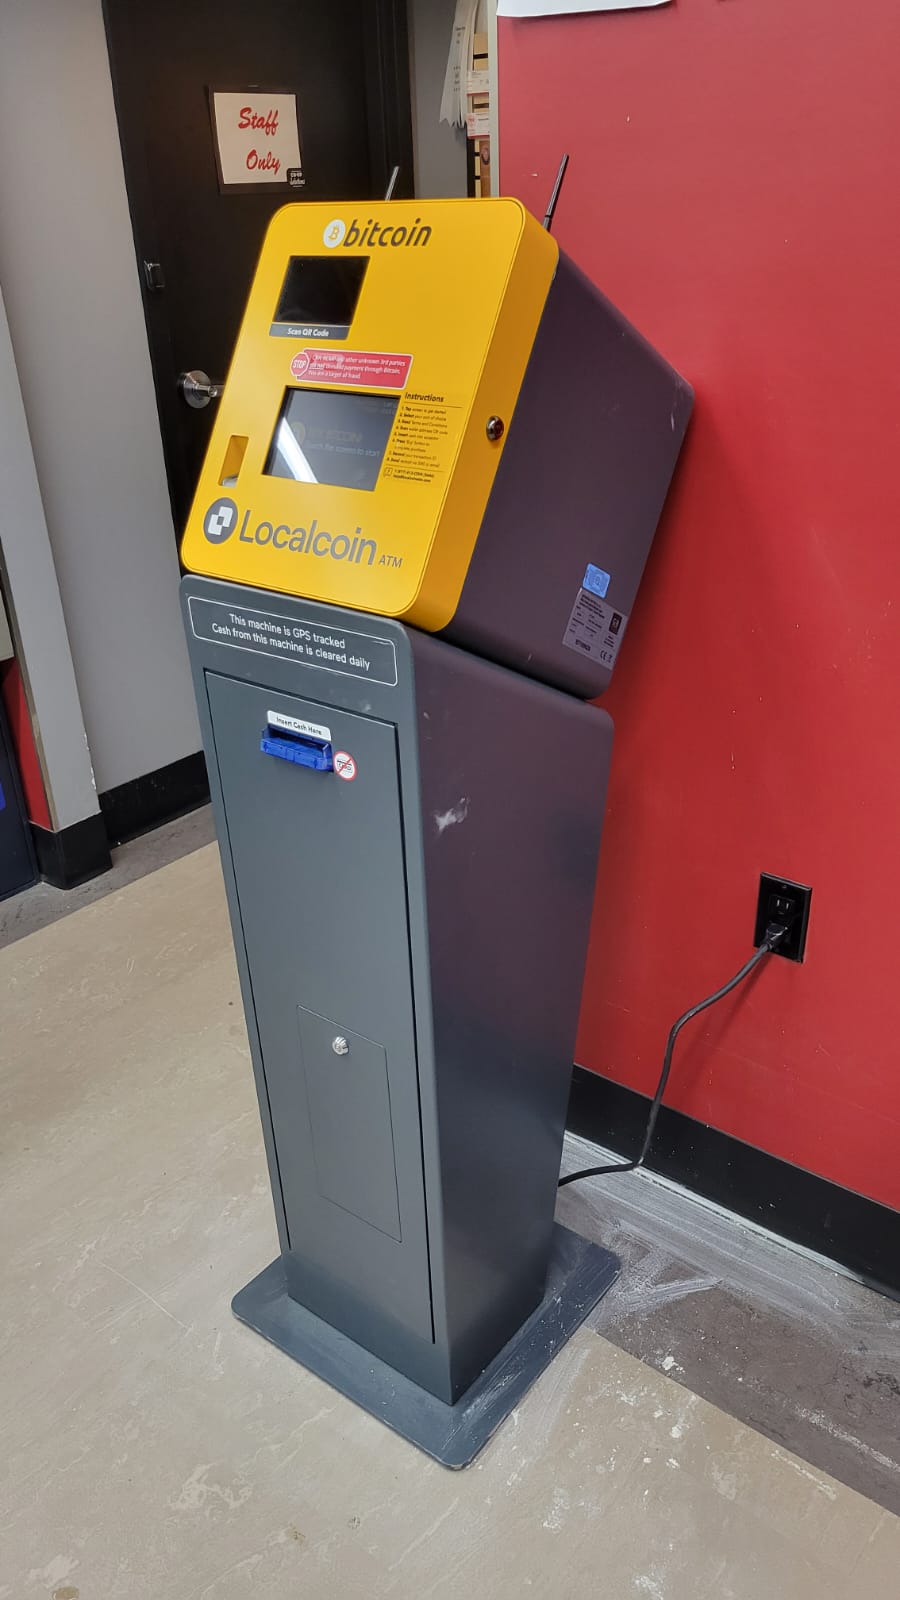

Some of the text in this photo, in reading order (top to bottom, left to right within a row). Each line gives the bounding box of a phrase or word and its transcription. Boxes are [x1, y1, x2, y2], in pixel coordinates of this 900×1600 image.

[238, 107, 279, 136] Staff
[246, 149, 281, 175] Only
[343, 217, 432, 247] bitcoin
[287, 327, 329, 337] Scan QR Code
[292, 360, 306, 369] STOP
[404, 391, 444, 402] Instructions
[239, 509, 403, 568] Localcoin ATM
[228, 612, 346, 649] This machine is GPS tracked
[211, 622, 371, 671] Cash from this machine is cleared daily
[276, 715, 322, 735] Insert Cash Here
